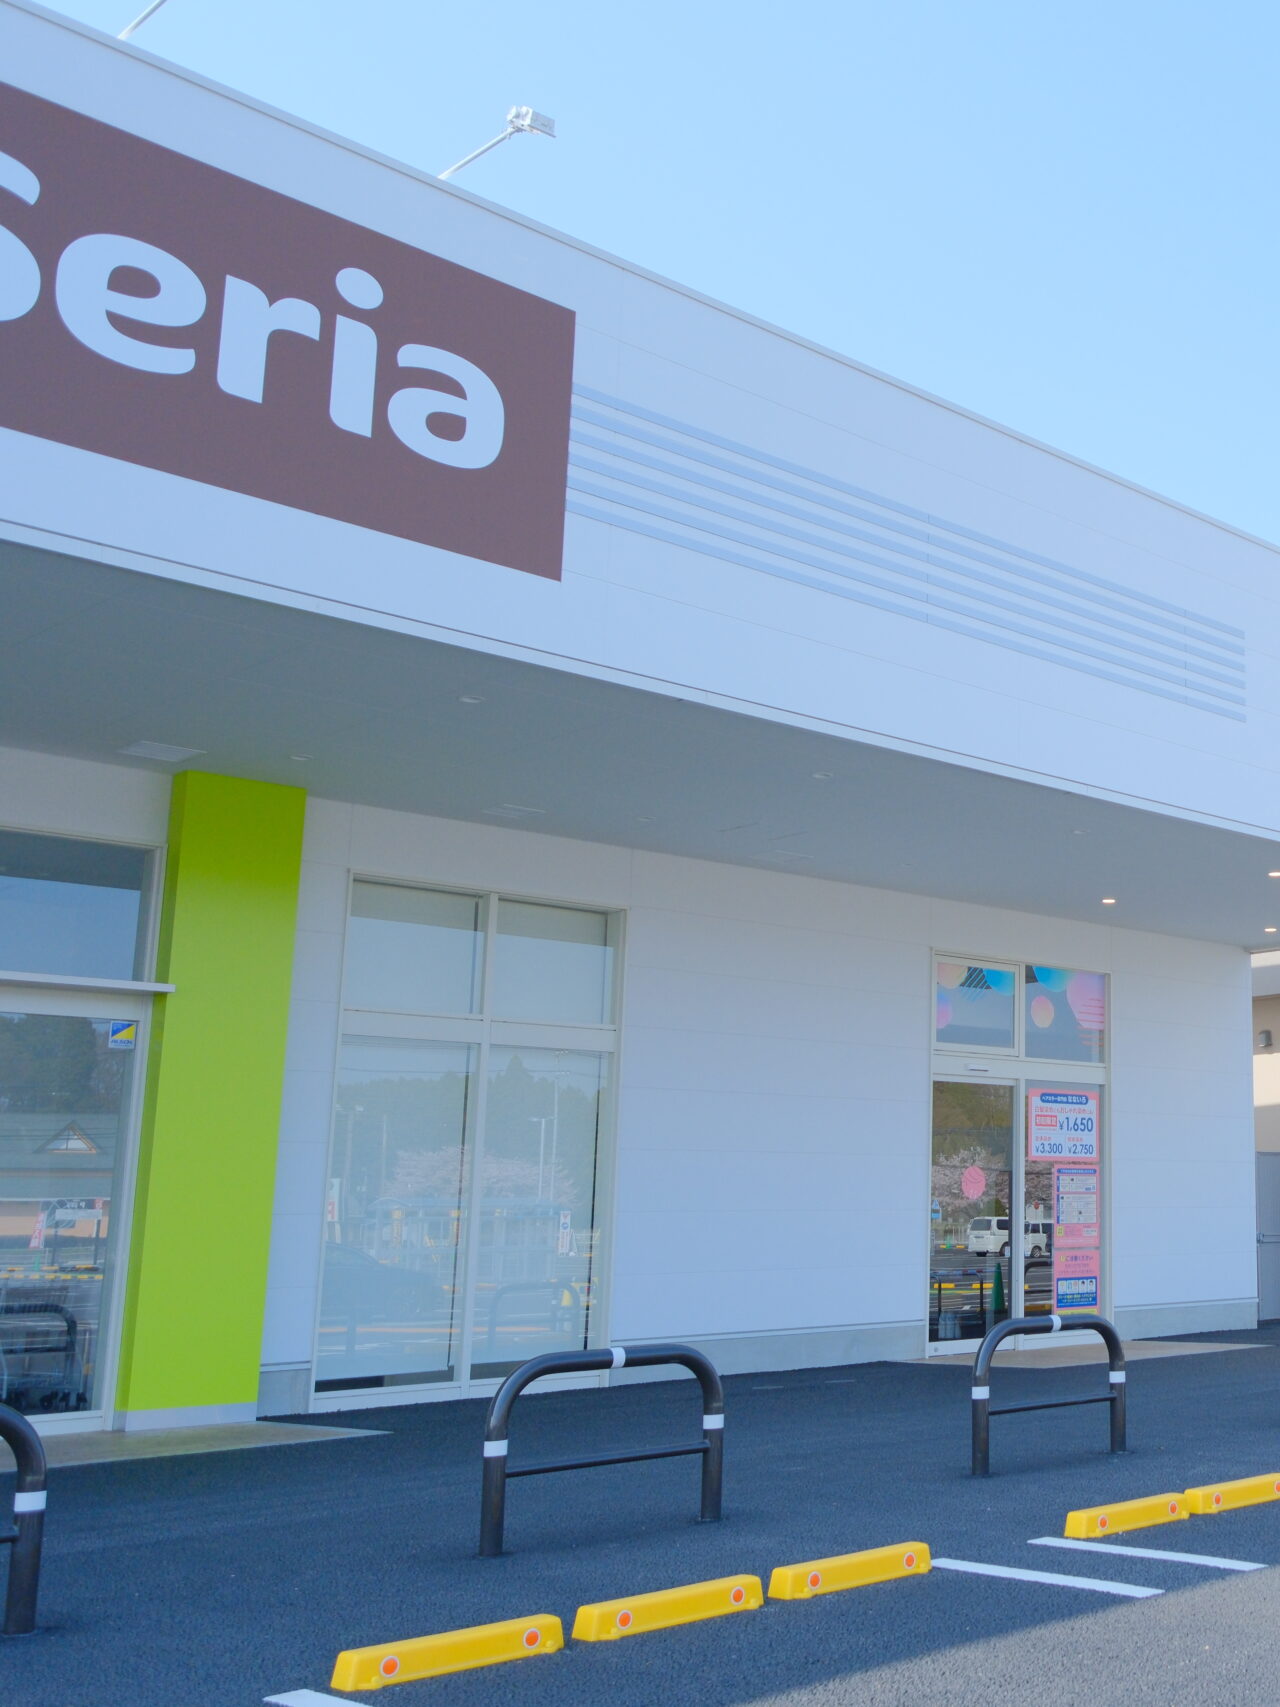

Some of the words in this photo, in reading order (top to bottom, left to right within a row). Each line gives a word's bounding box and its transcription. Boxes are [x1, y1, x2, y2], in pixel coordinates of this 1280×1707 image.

[1058, 1116, 1094, 1133] ¥1,650
[1035, 1143, 1063, 1154] ¥3,300
[1067, 1143, 1094, 1155] ¥2,750
